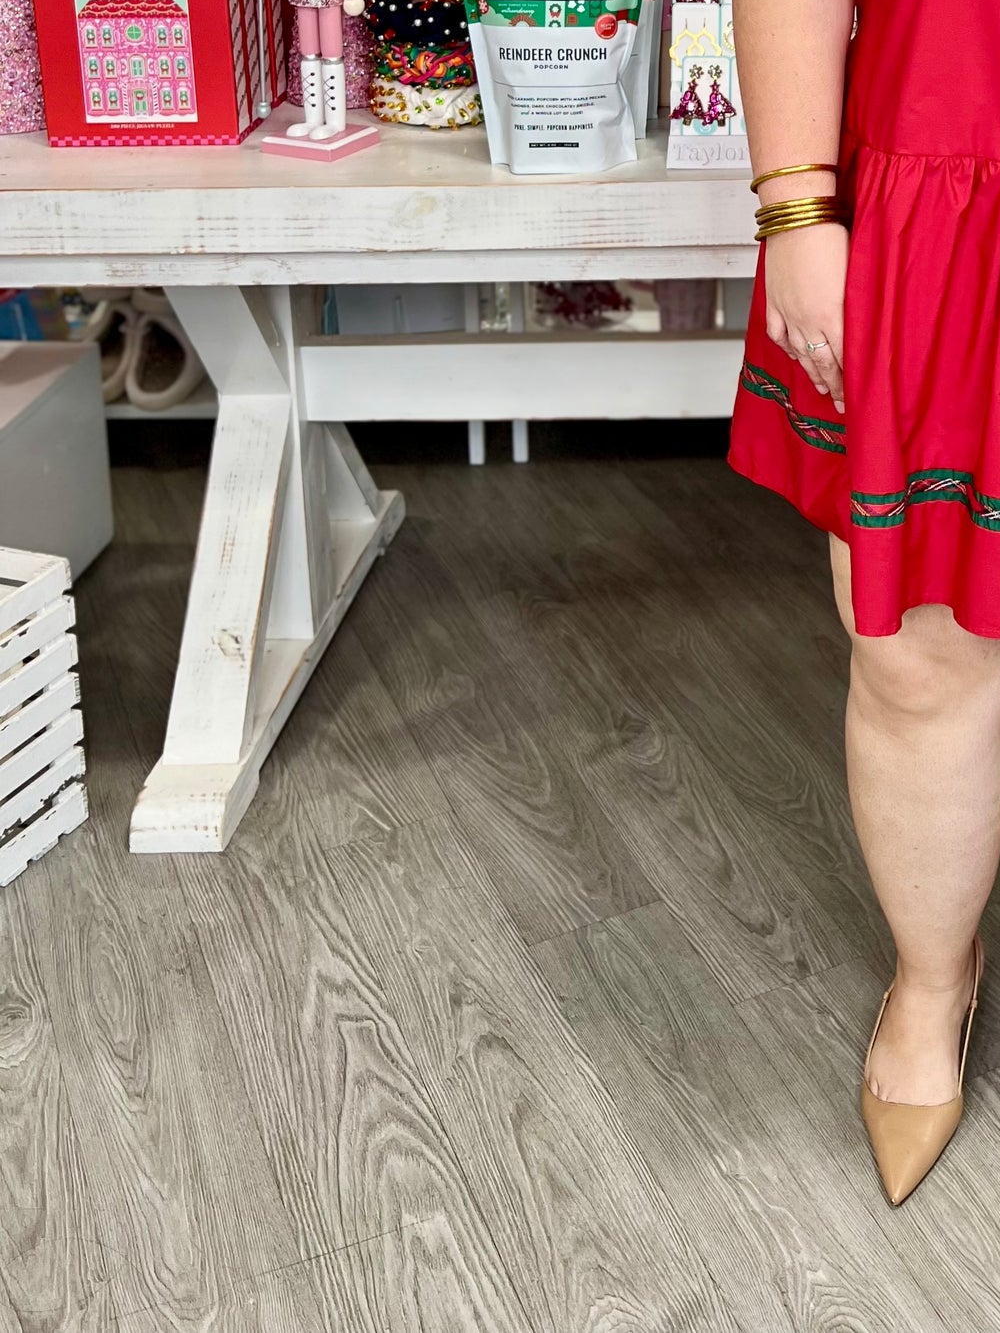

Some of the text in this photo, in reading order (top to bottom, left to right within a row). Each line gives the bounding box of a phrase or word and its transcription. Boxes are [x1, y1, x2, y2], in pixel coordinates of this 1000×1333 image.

[499, 47, 607, 61] REINDEER CRUNCH
[673, 143, 748, 166] Taylor
